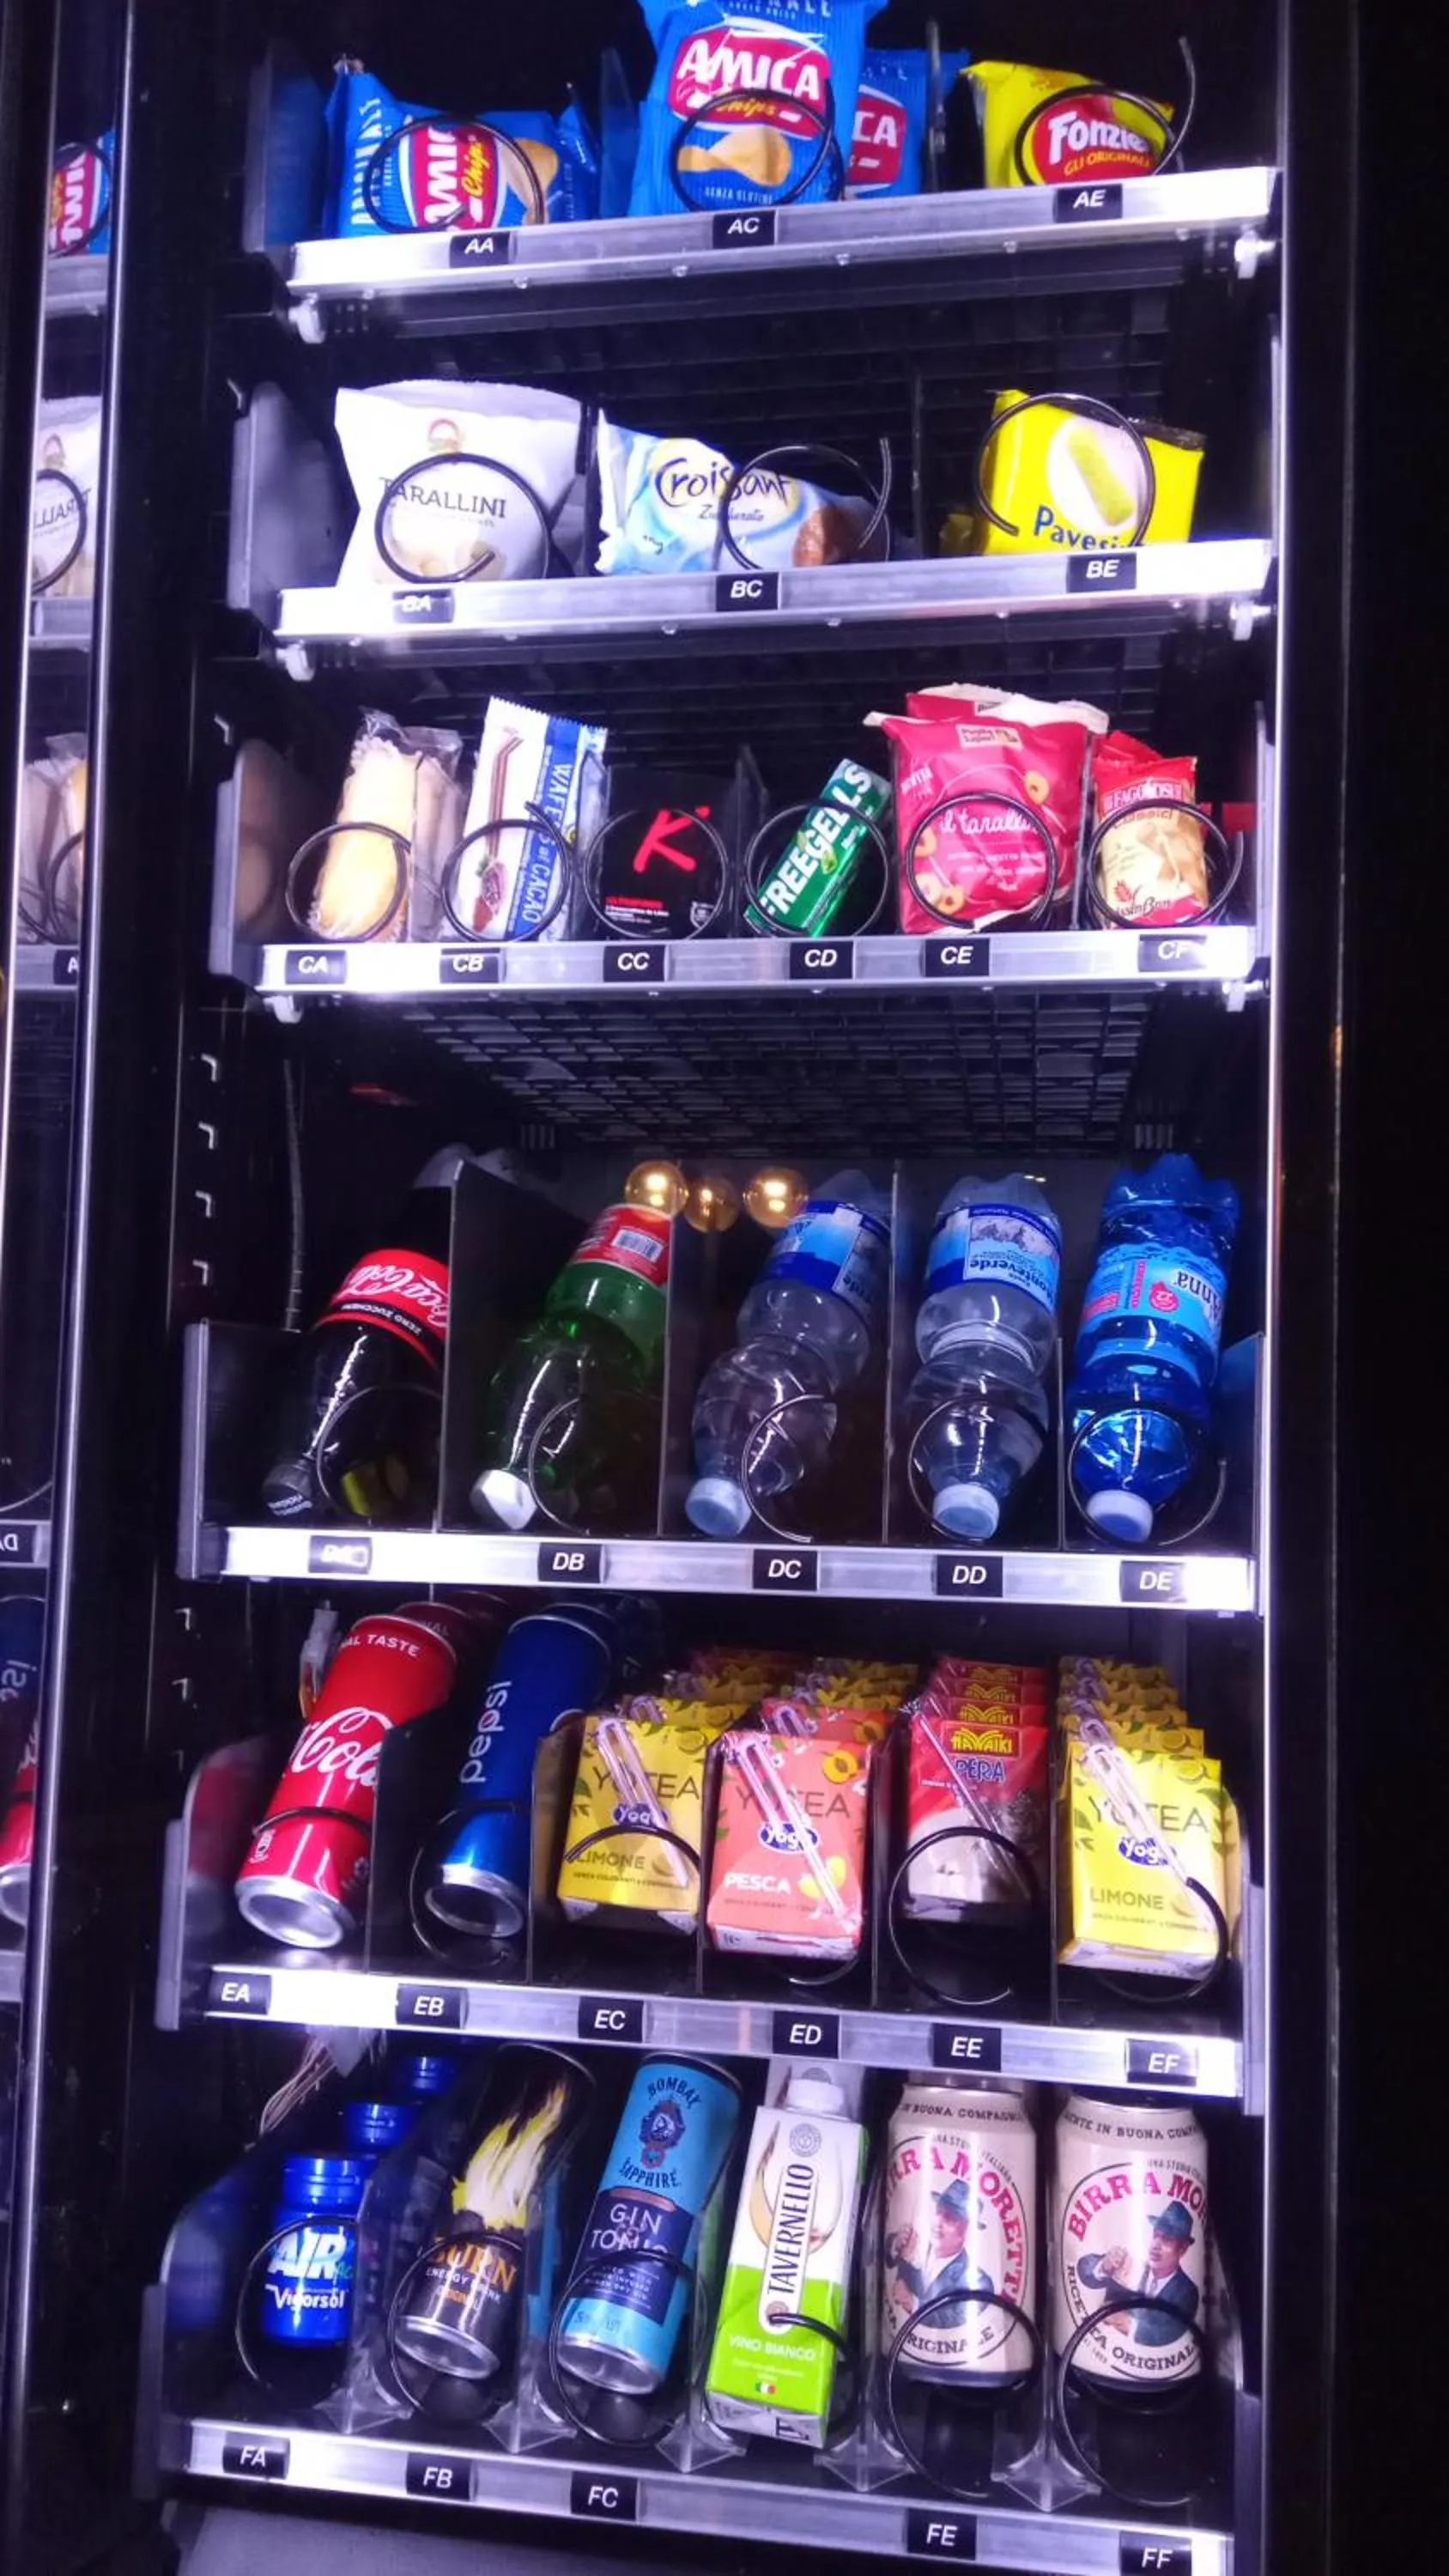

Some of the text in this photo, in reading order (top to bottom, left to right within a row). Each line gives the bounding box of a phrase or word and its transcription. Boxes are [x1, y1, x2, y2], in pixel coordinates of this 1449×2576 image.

[676, 38, 821, 100] AMICA
[1048, 111, 1150, 165] Fonzie
[1064, 156, 1084, 176] GLI
[1074, 190, 1106, 209] AE
[727, 217, 760, 235] AC
[464, 237, 494, 254] AA
[378, 477, 508, 519] TARALLINI
[1033, 504, 1137, 550] Pavesi
[1085, 558, 1120, 579] BE
[730, 580, 763, 598] BC
[538, 762, 573, 847] WAFES
[522, 865, 552, 924] CACAO
[297, 956, 328, 974] CA
[452, 957, 484, 973] CB
[617, 951, 650, 971] CC
[803, 948, 837, 967] CD
[940, 945, 973, 964] CE
[552, 1552, 585, 1571] DB
[768, 1559, 802, 1578] DC
[952, 1565, 986, 1585] DD
[1139, 1571, 1173, 1591] DE
[367, 1632, 422, 1657] TASTE
[459, 1680, 513, 1784] pepsi
[954, 1757, 1008, 1783] PERA
[576, 1850, 646, 1873] LIMONE
[724, 1873, 791, 1895] PESCA
[1089, 1887, 1165, 1911] LIMONE
[221, 1982, 252, 2004] EA
[414, 1997, 446, 2016] EB
[594, 2009, 627, 2031] EC
[789, 2025, 822, 2045] ED
[950, 2037, 984, 2058] EE
[1148, 2052, 1182, 2075] EF
[646, 2075, 702, 2110] BOMBAY
[911, 2104, 954, 2117] BUONA
[1096, 2122, 1112, 2135] IN
[1116, 2127, 1164, 2140] BUONA
[618, 2156, 682, 2189] SAPPHIRE
[1067, 2171, 1162, 2243] BIRRA
[609, 2202, 663, 2237] GIN
[767, 2162, 815, 2296] TAVERNELLO
[266, 2231, 348, 2281] AIR
[425, 2267, 470, 2287] ENEGY
[264, 2283, 347, 2312] Vigorsol
[904, 2325, 995, 2354] RIGINAE
[765, 2342, 817, 2362] BIANCO
[1112, 2343, 1196, 2372] ORIGINAL
[239, 2445, 267, 2469] FA
[422, 2467, 454, 2489] FB
[587, 2486, 620, 2509] FC
[925, 2524, 957, 2548] FE
[1141, 2548, 1173, 2570] FF
